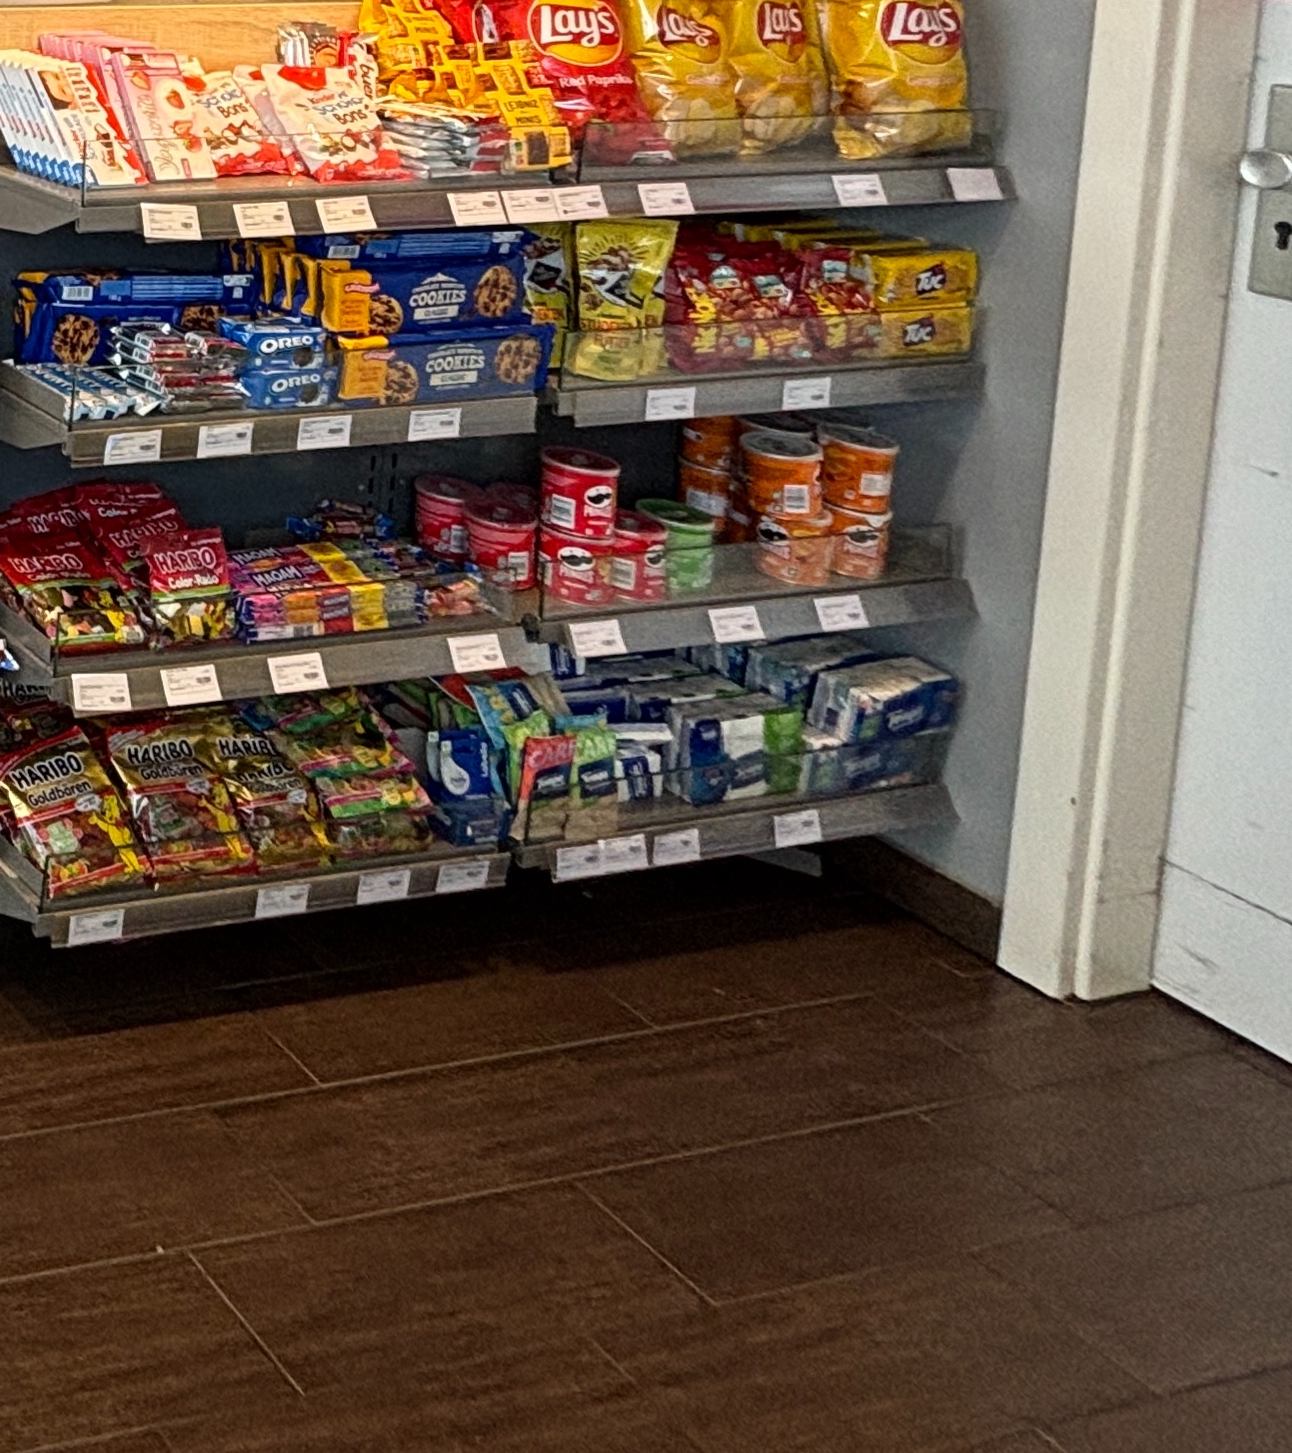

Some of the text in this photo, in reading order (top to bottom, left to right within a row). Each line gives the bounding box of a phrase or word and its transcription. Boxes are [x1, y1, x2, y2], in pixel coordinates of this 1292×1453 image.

[540, 4, 615, 45] Lay's
[887, 2, 959, 46] Lay's
[216, 103, 247, 118] Bons
[335, 109, 366, 124] Bons
[409, 290, 466, 307] COOKIES
[260, 334, 314, 355] OREO
[425, 355, 485, 373] COOKIES
[271, 373, 321, 393] OREO
[153, 547, 217, 574] HARIBO
[252, 565, 301, 588] MAOAM
[126, 739, 194, 764] HARIBO
[11, 754, 84, 788] HARIBO
[139, 764, 203, 780] Goldbären
[27, 779, 92, 808] Goldbären
